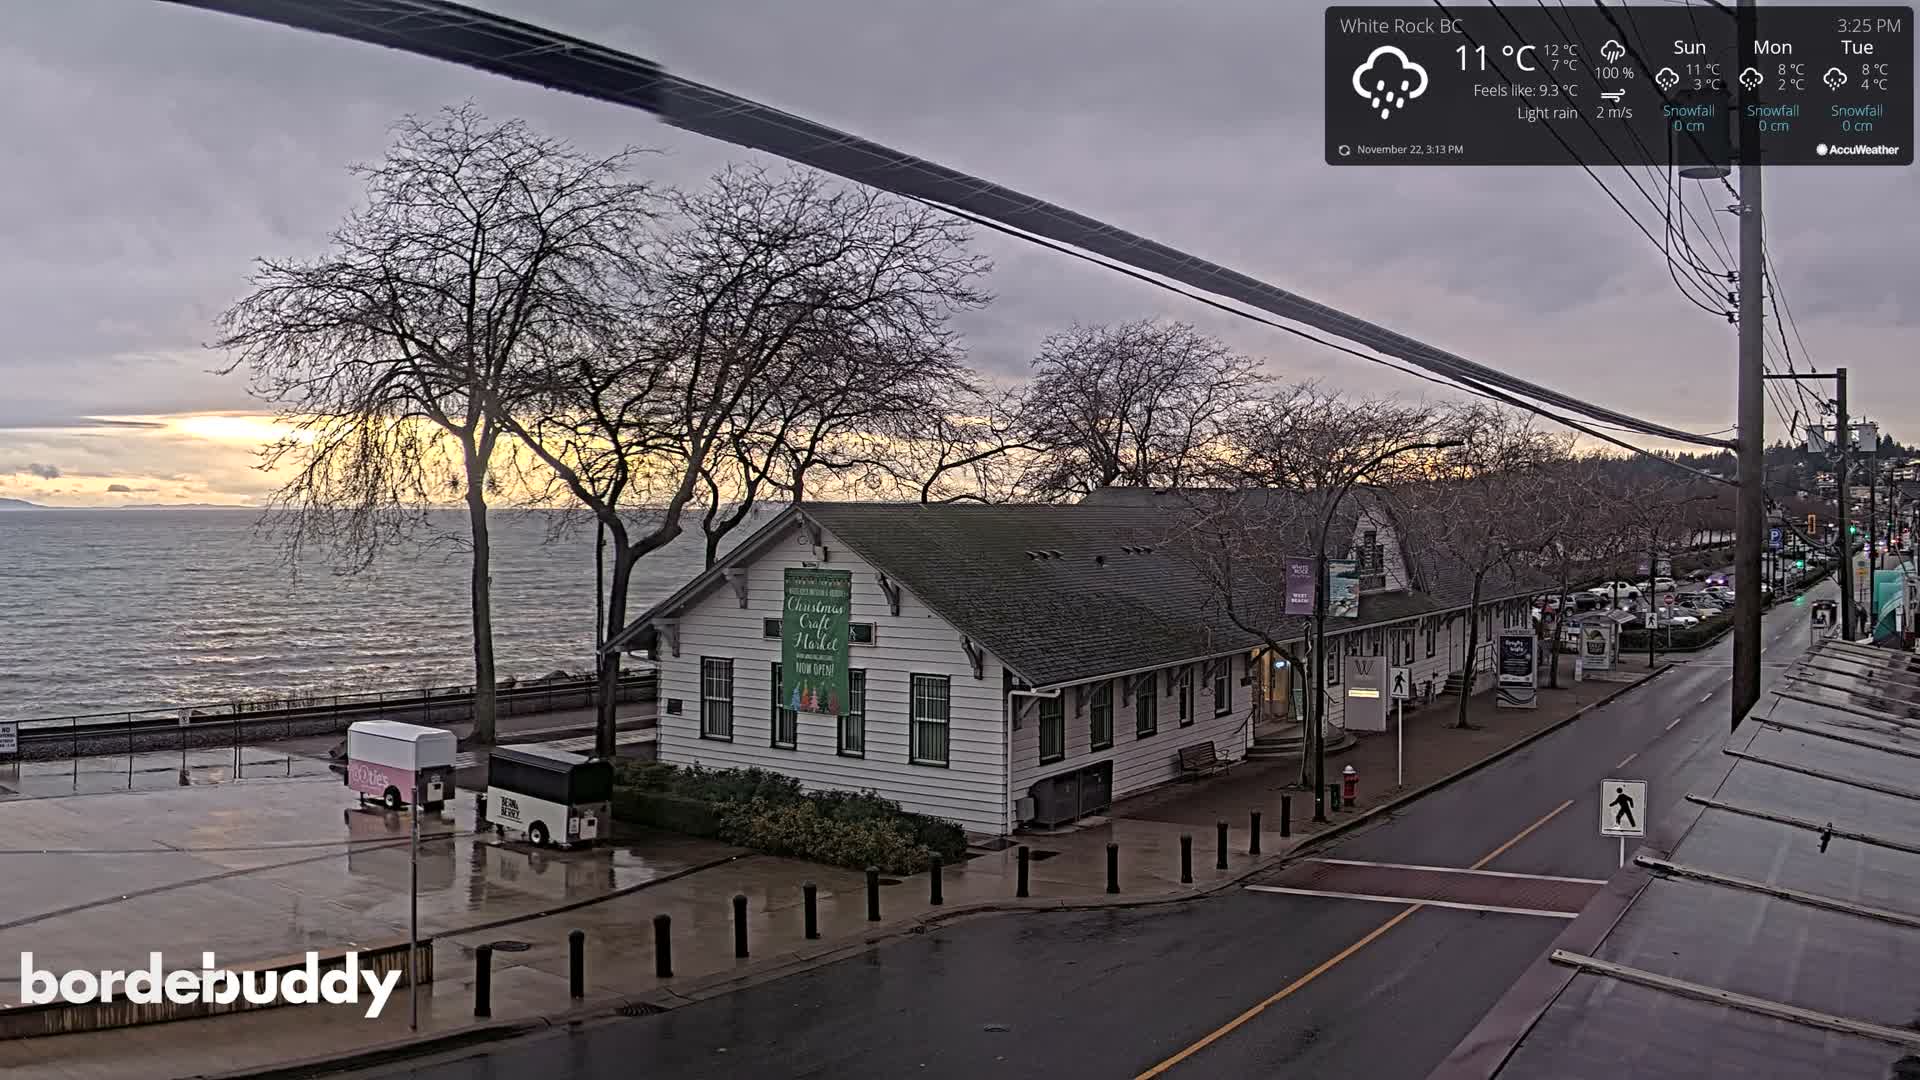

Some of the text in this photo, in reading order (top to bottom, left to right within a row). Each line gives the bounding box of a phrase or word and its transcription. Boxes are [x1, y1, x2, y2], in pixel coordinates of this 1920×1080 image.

[788, 595, 843, 614] Christmas
[799, 612, 831, 639] Craft
[793, 631, 839, 651] Market
[795, 661, 834, 677] NOW OPEN!
